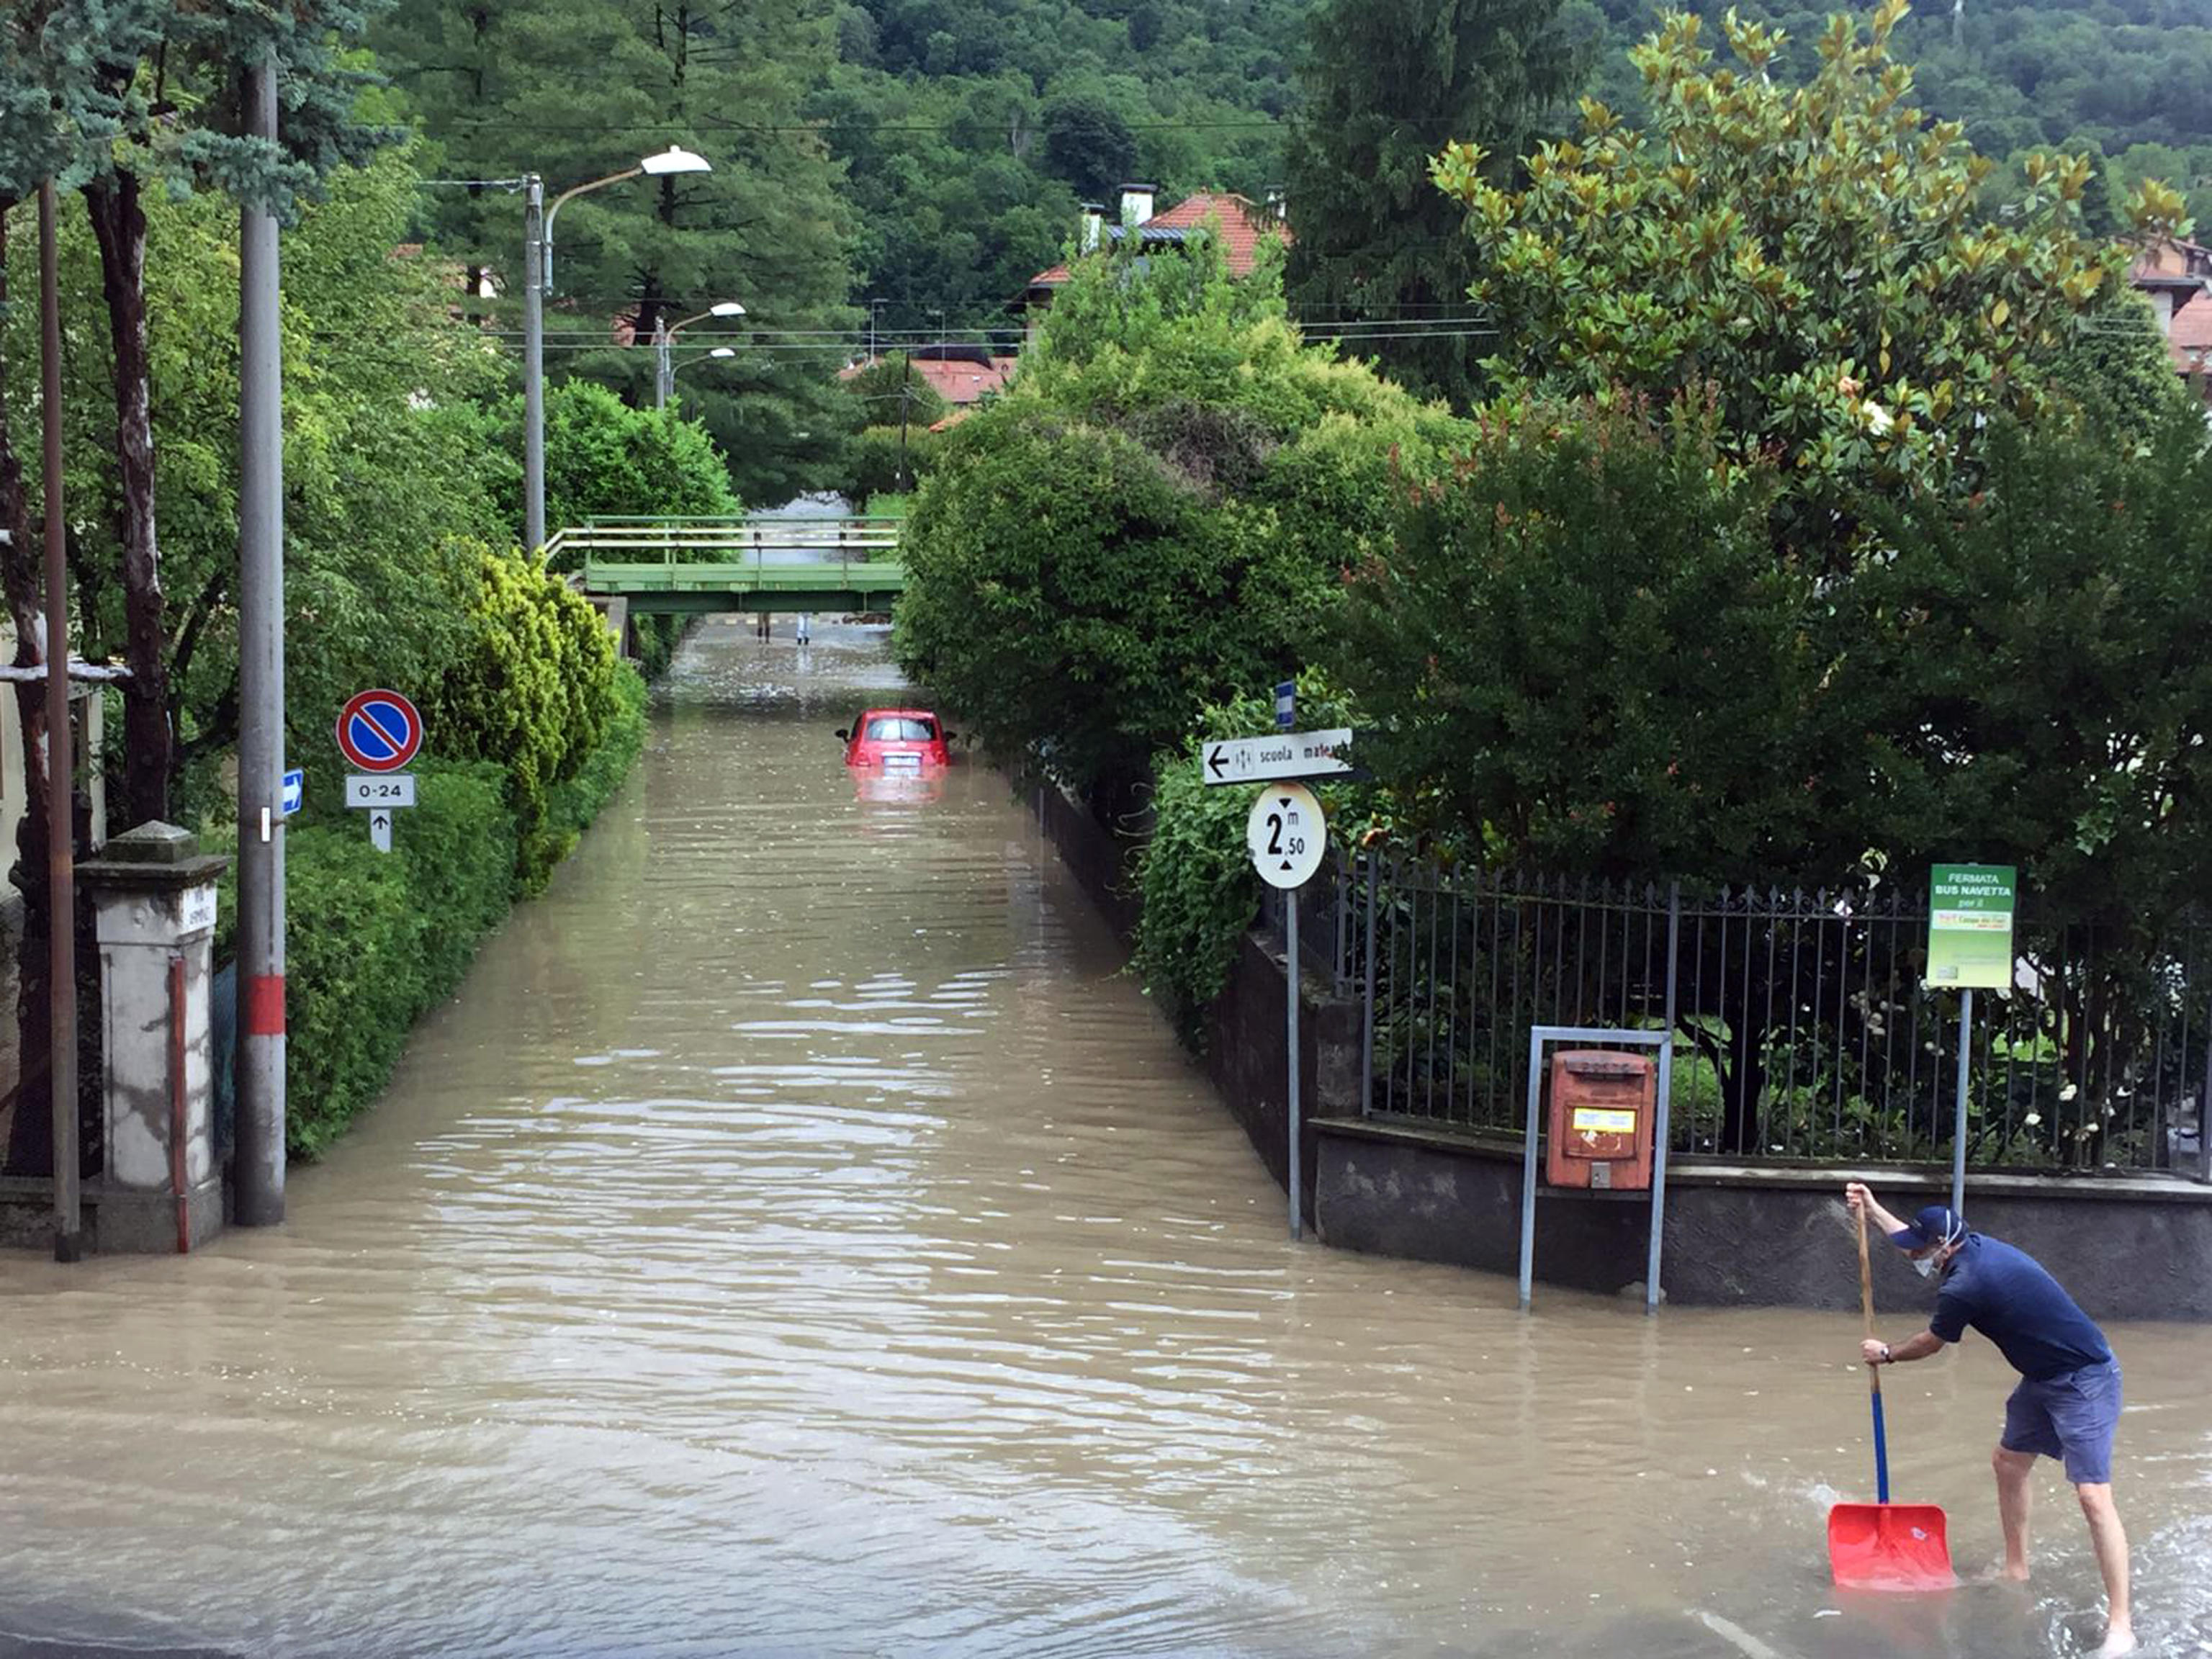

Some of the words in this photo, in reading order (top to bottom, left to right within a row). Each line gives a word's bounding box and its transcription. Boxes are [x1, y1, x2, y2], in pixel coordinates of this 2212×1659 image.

[1260, 746, 1292, 763] scuola
[359, 785, 401, 797] 0-24
[1287, 812, 1298, 824] m
[1948, 873, 1999, 884] FERMATA
[1936, 885, 1959, 894] BUS
[1961, 886, 2011, 896] NAVETTA
